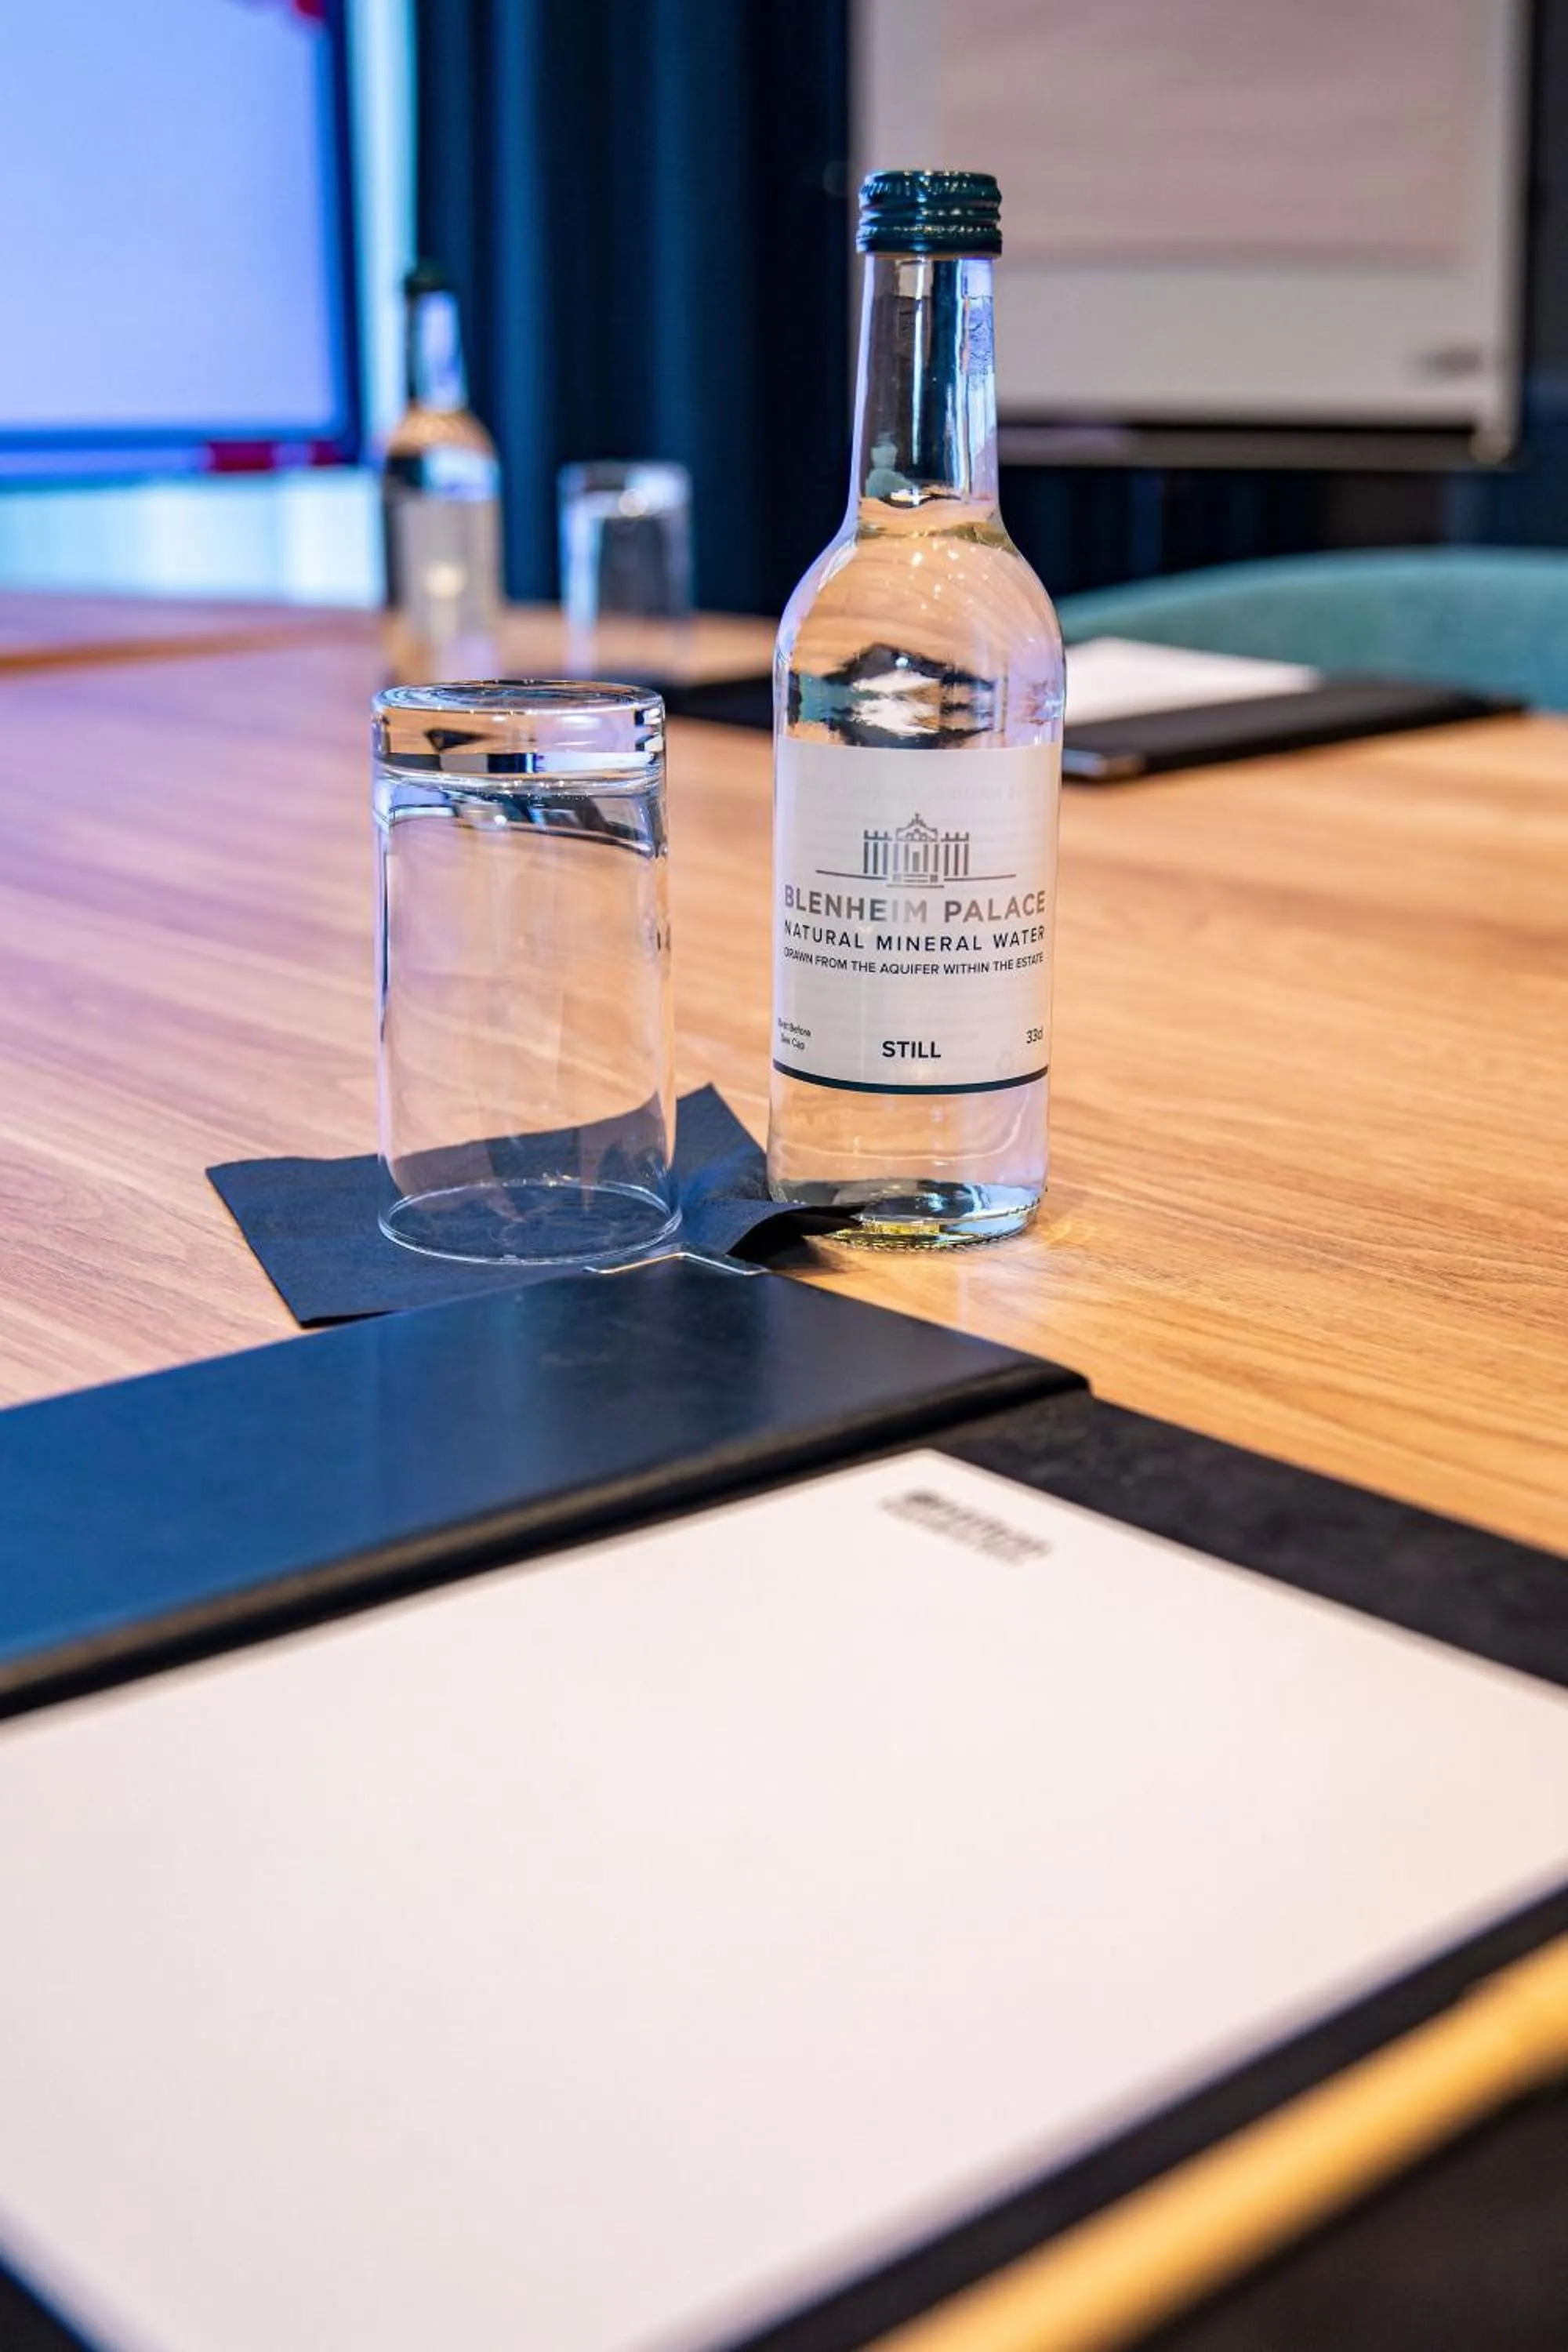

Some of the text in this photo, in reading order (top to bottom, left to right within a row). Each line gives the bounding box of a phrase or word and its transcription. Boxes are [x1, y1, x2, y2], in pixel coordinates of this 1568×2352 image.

[785, 884, 1046, 924] BLENHEIM PALACE
[785, 920, 1045, 952] NATURAL MINERAL WATER
[784, 946, 1044, 975] DRAWN FROM THE AQUIFER WITHIN THE ESTATE
[882, 1040, 942, 1058] STILL
